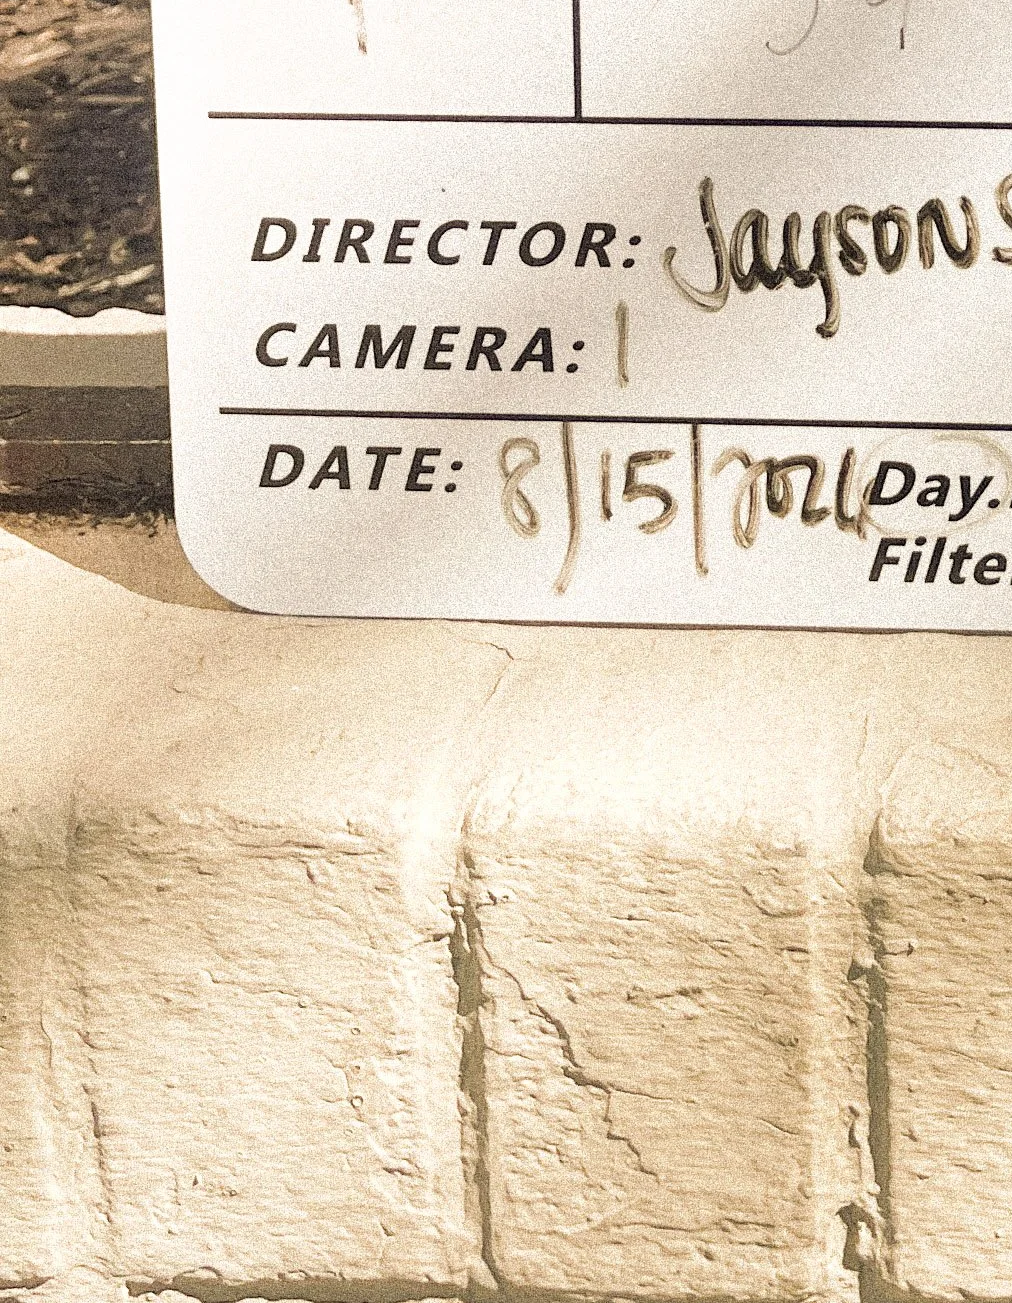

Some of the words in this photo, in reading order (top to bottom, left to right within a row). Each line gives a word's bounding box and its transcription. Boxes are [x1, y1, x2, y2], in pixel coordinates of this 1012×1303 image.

[250, 216, 642, 269] DIRECTOR:
[256, 321, 586, 374] CAMERA:
[258, 443, 464, 492] DATE:
